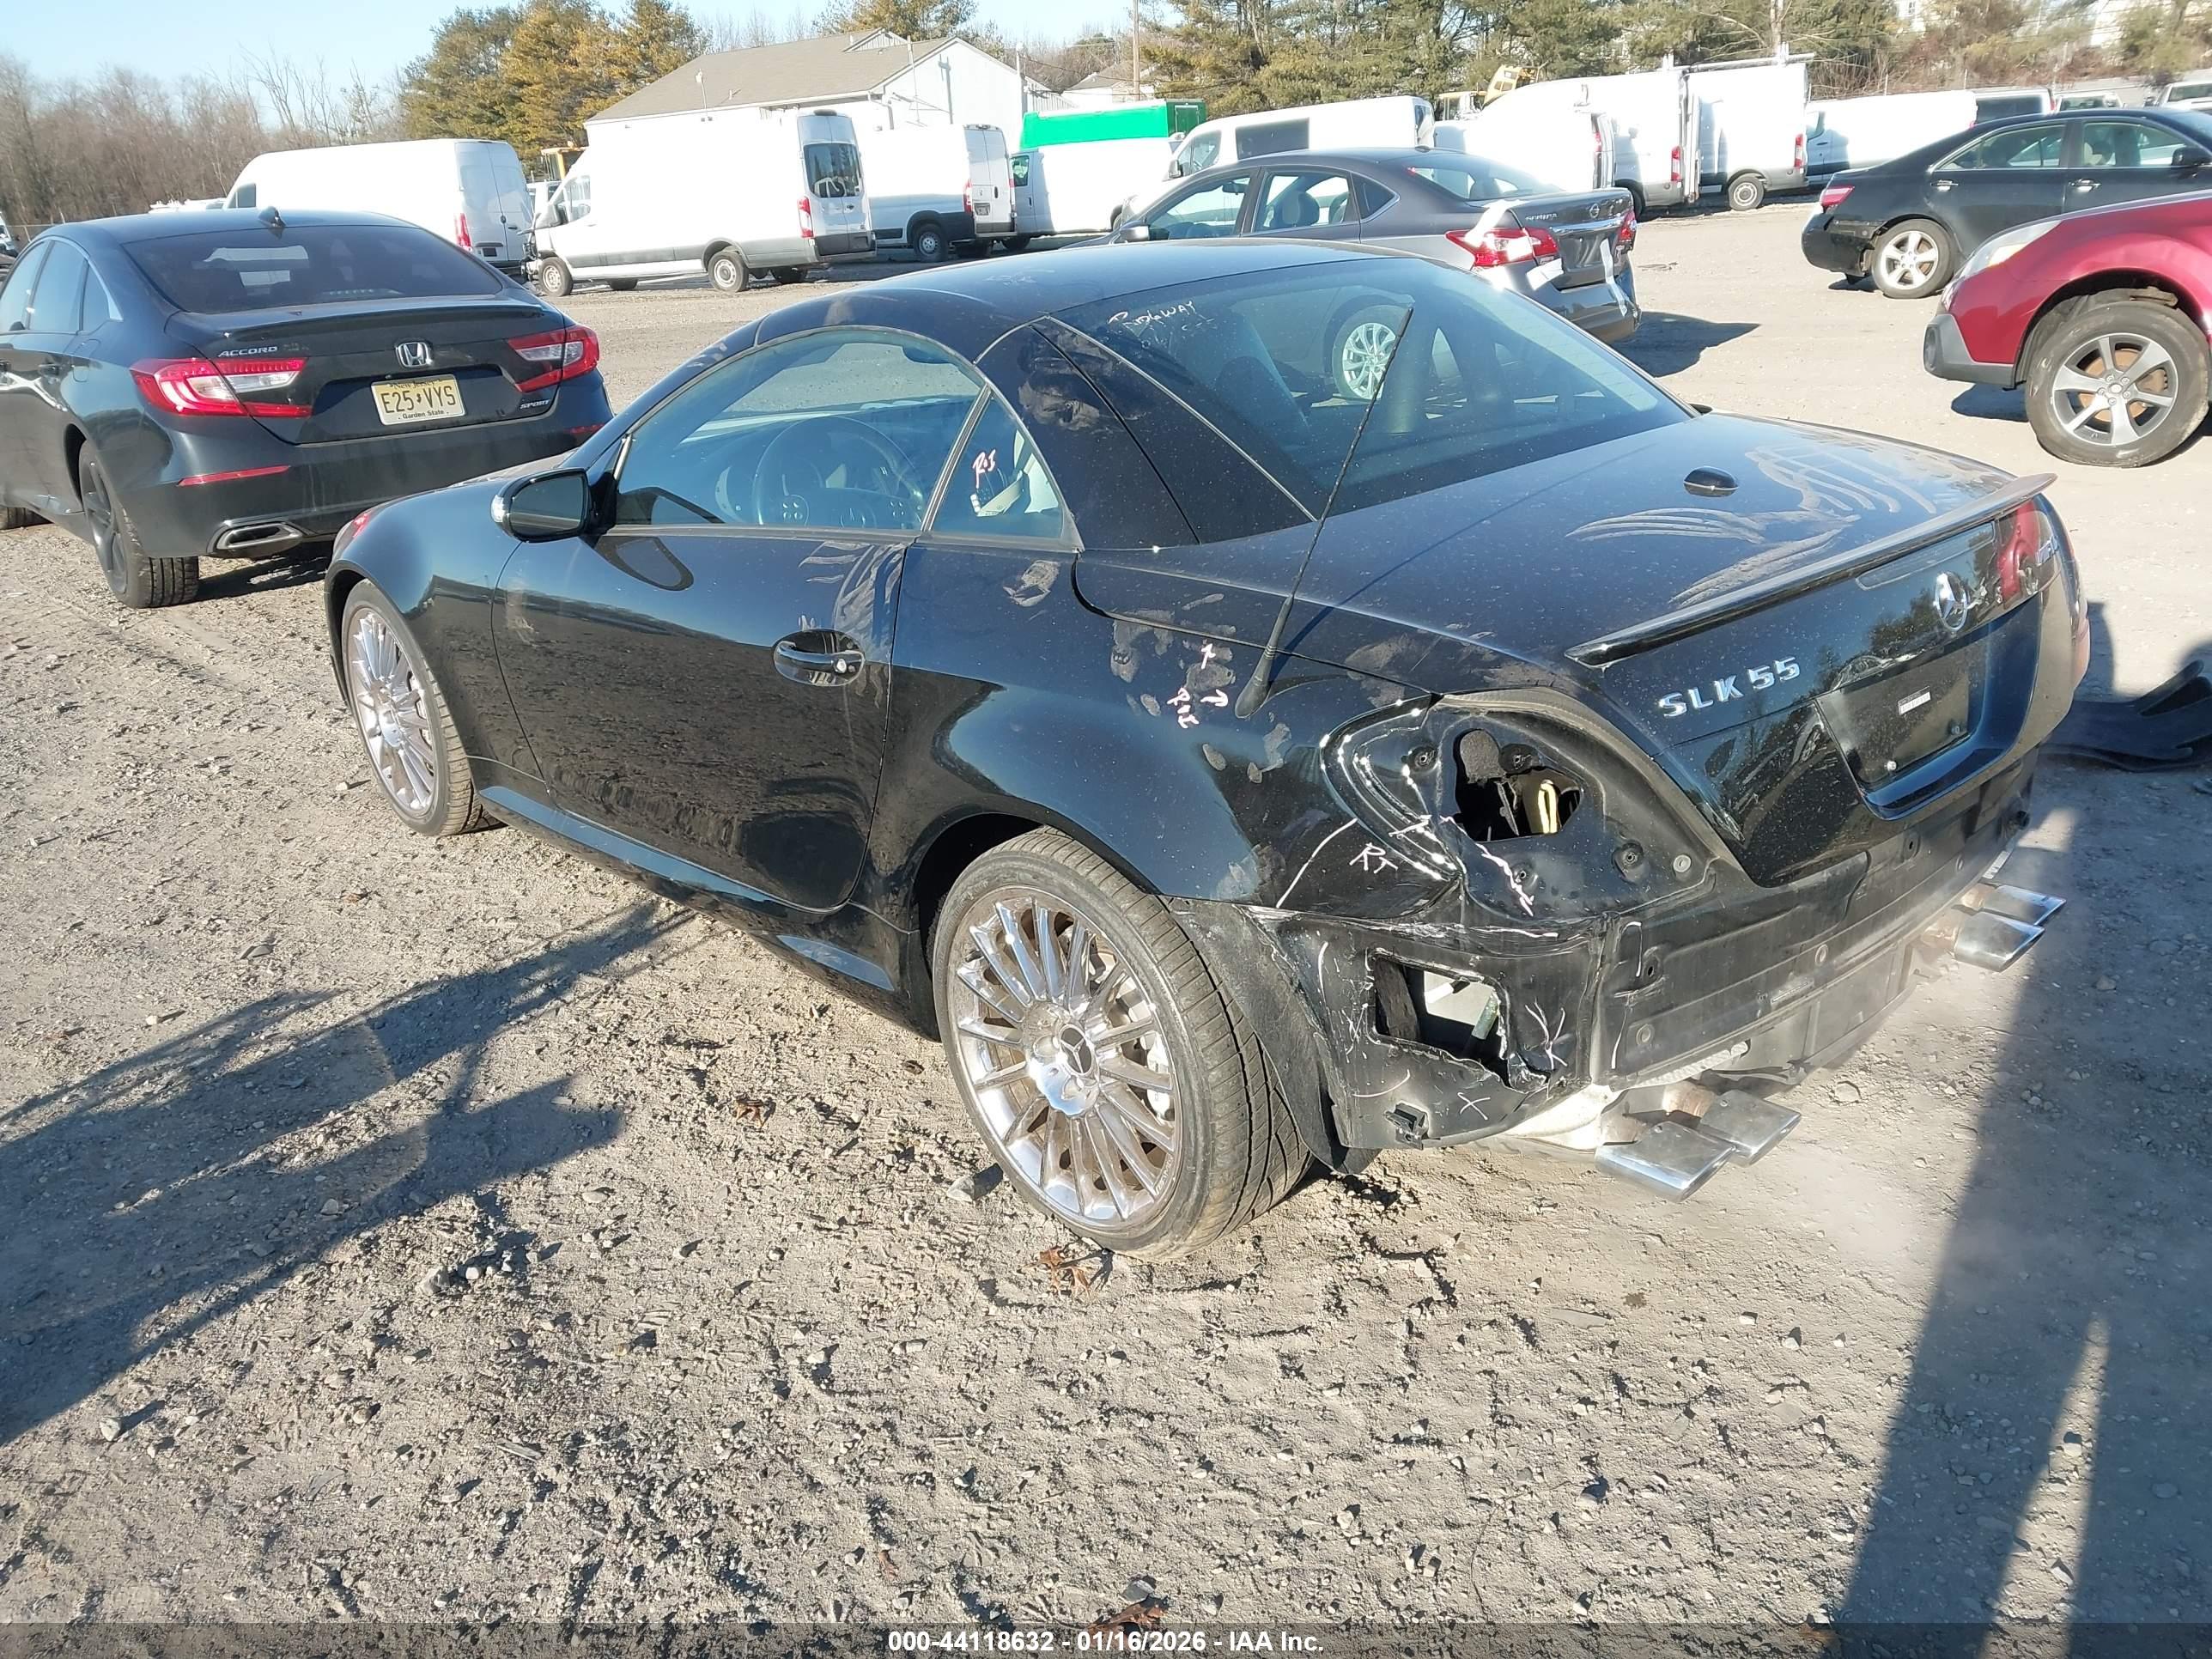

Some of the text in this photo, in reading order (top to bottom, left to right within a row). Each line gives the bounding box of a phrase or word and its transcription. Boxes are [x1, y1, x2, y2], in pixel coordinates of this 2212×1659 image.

[218, 346, 277, 357] ACCORD
[380, 385, 456, 413] E25 VYS
[520, 399, 550, 410] SPORT
[1658, 656, 1801, 717] SLK 55
